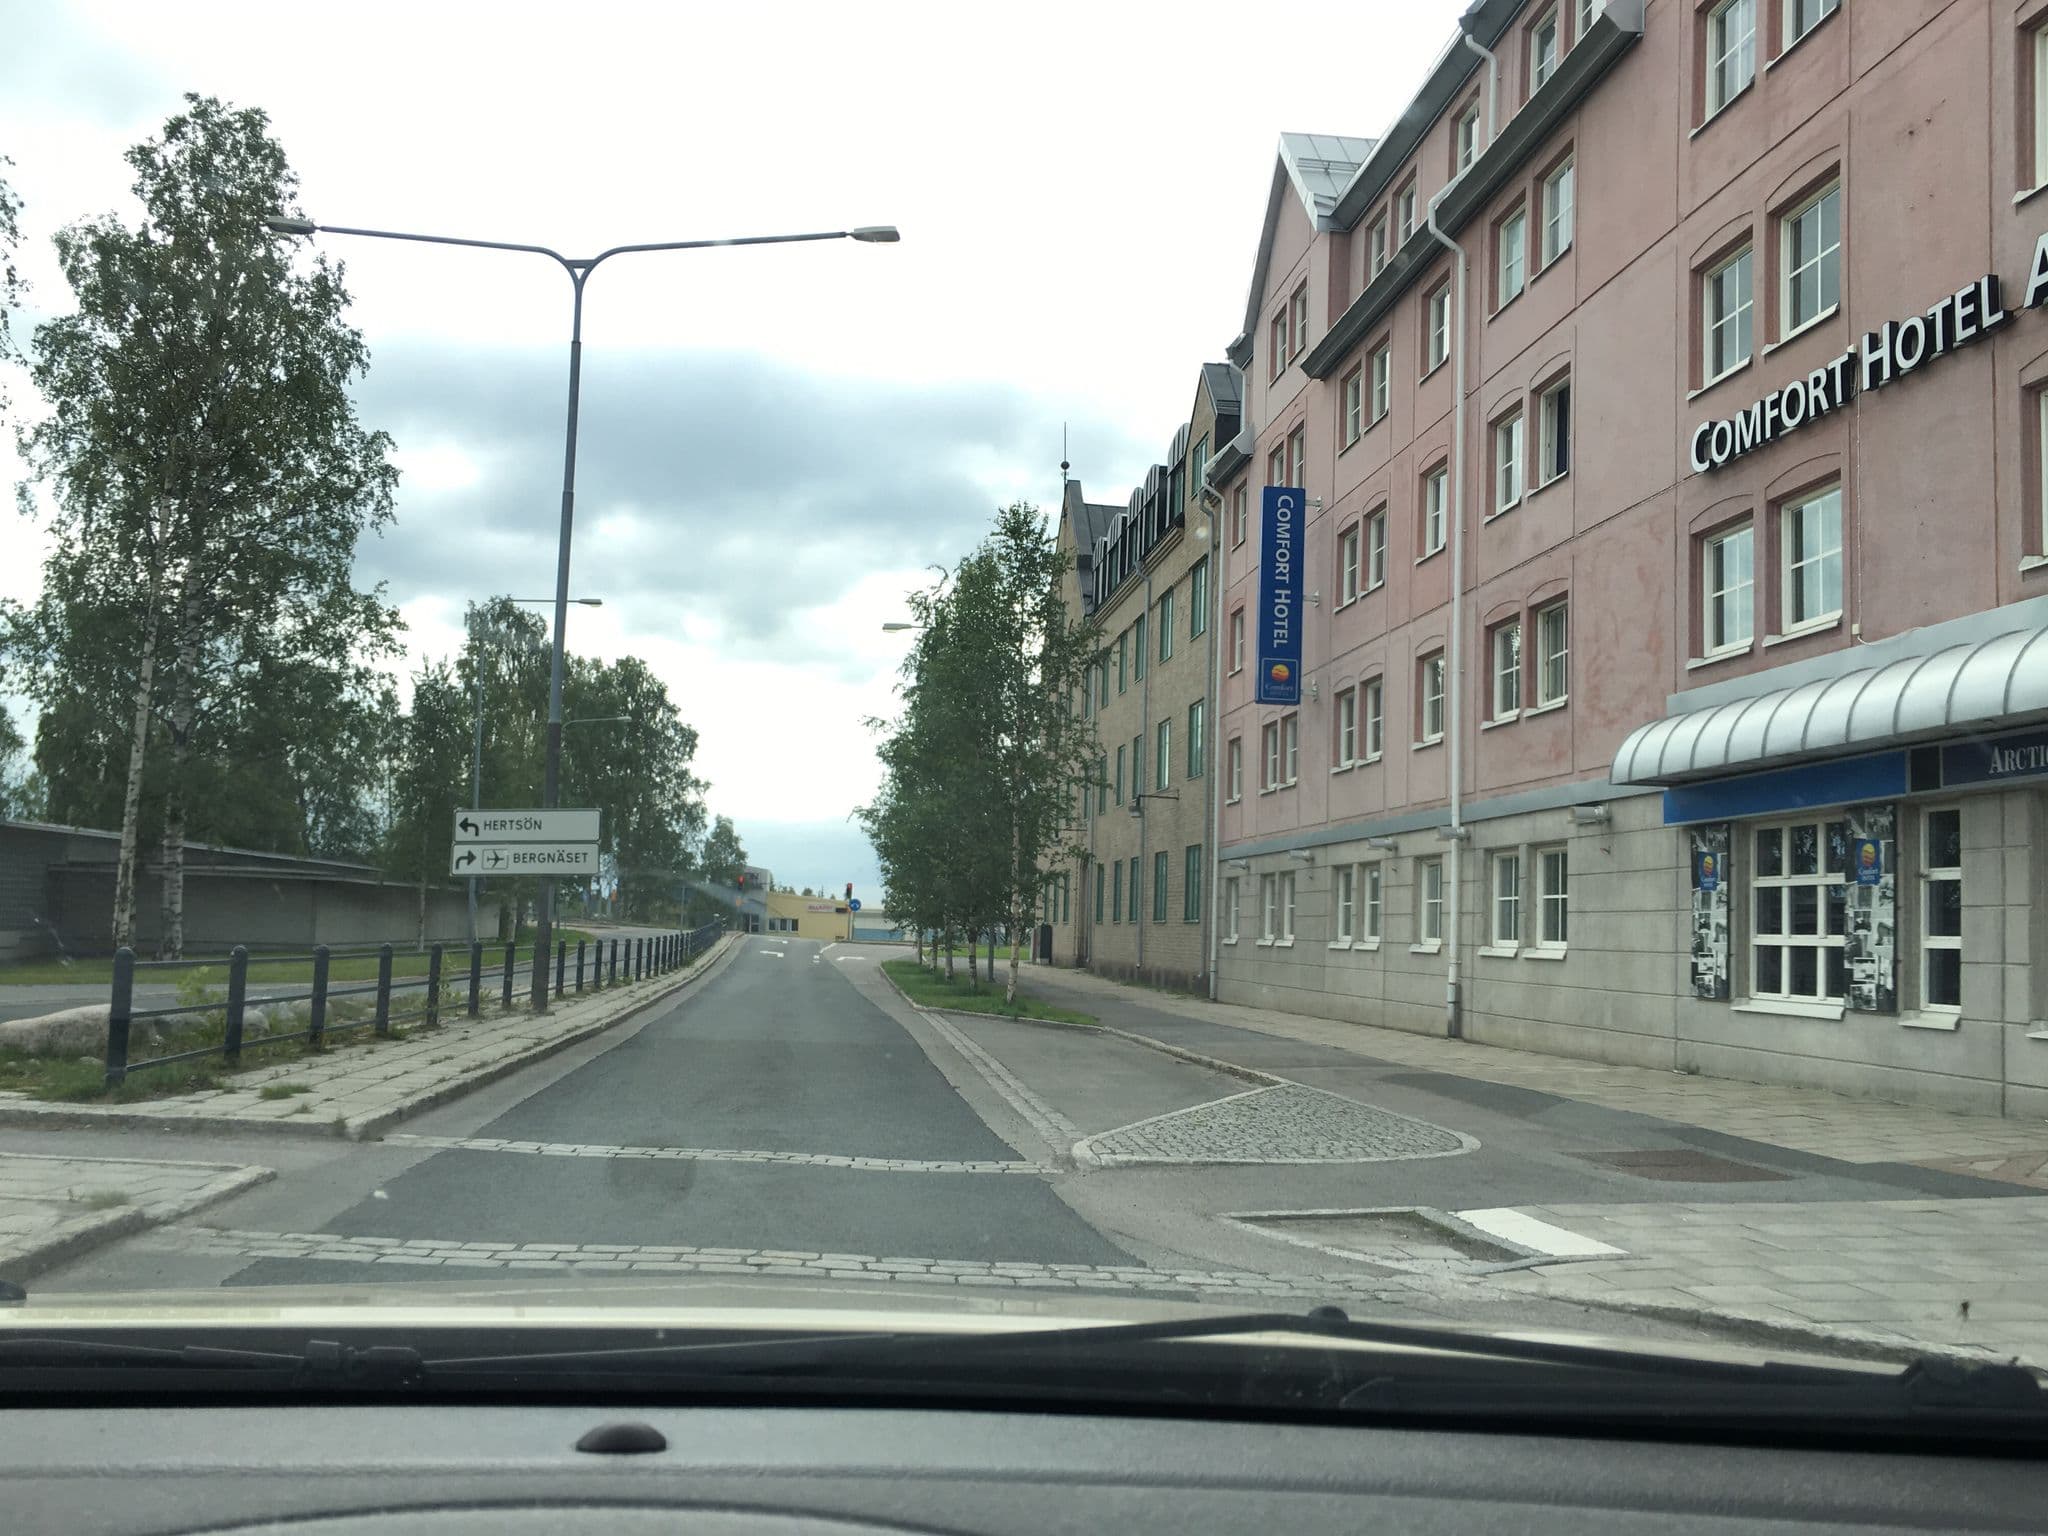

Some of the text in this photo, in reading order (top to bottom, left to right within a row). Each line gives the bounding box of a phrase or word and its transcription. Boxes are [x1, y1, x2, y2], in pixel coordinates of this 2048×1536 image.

[1691, 350, 1854, 474] COMFORT
[1862, 274, 2006, 391] HOTEL
[1273, 495, 1293, 649] COMFORT HOTEL
[1988, 744, 2048, 774] ARCTI
[483, 817, 542, 830] HERTSÖN
[513, 850, 588, 863] BERGNÄSET
